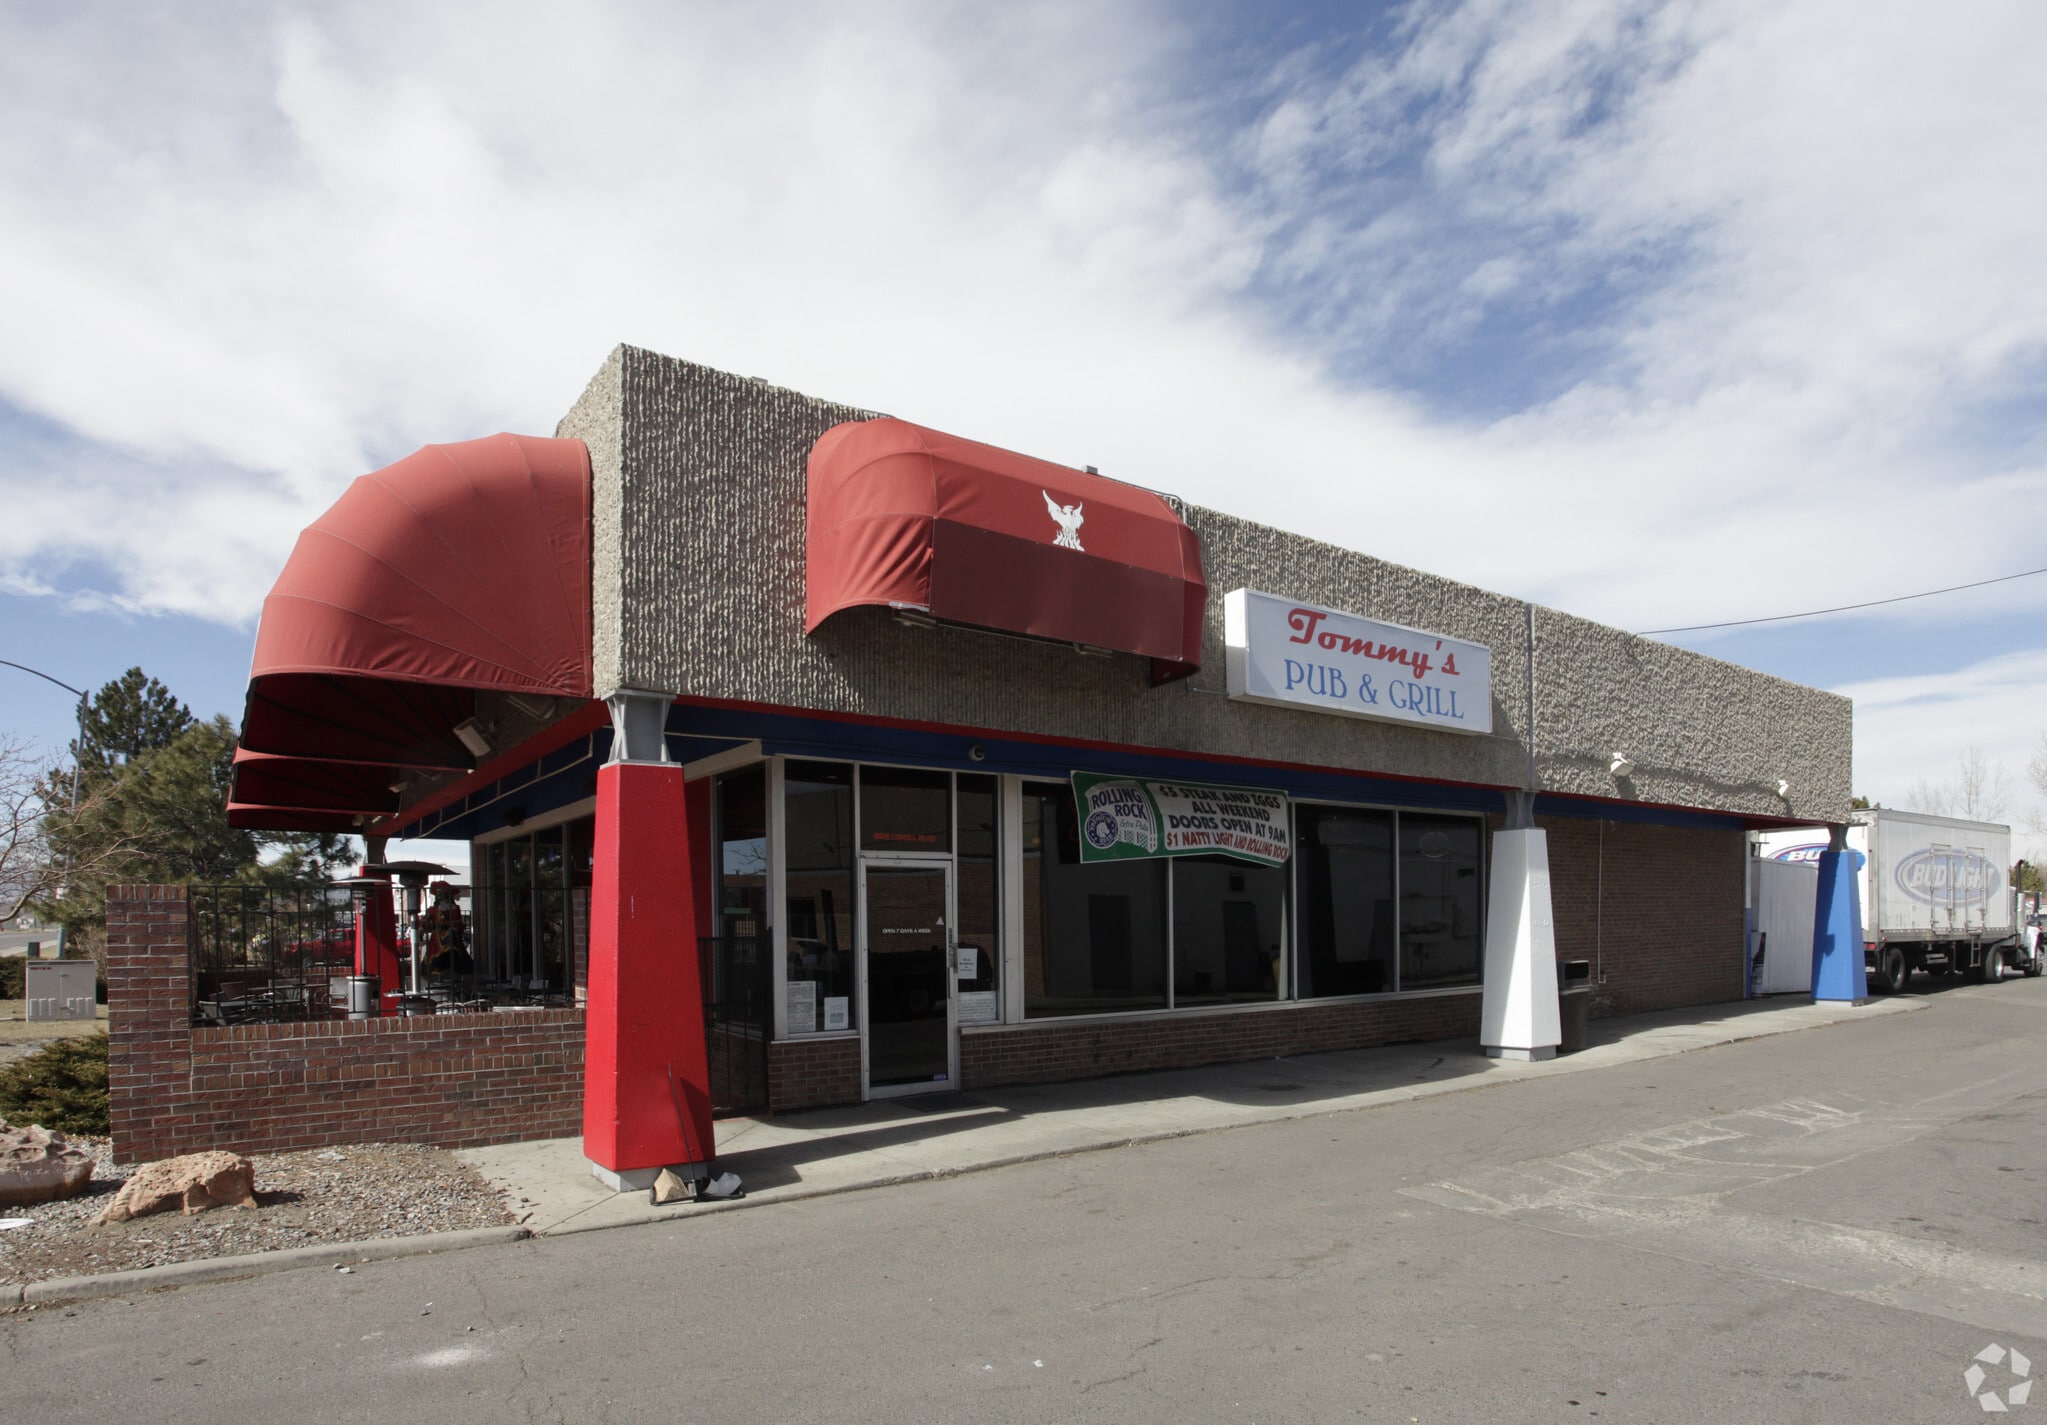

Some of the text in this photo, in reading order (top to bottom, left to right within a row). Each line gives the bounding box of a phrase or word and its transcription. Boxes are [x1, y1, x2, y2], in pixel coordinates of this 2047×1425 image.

[1287, 608, 1461, 679] Tommy's
[1284, 659, 1465, 719] PUB & GRILL
[1093, 789, 1142, 809] ROLLING
[1160, 786, 1281, 809] $5 STEAK AND EGGS
[1114, 803, 1148, 820] ROCK
[1192, 801, 1270, 821] ALL WEEKEND
[1169, 815, 1287, 844] DOORS OPEN AT 9AM
[1166, 832, 1289, 861] $1 NATTY LIGHT AND ROLLING ROCK
[1787, 850, 1821, 861] BU
